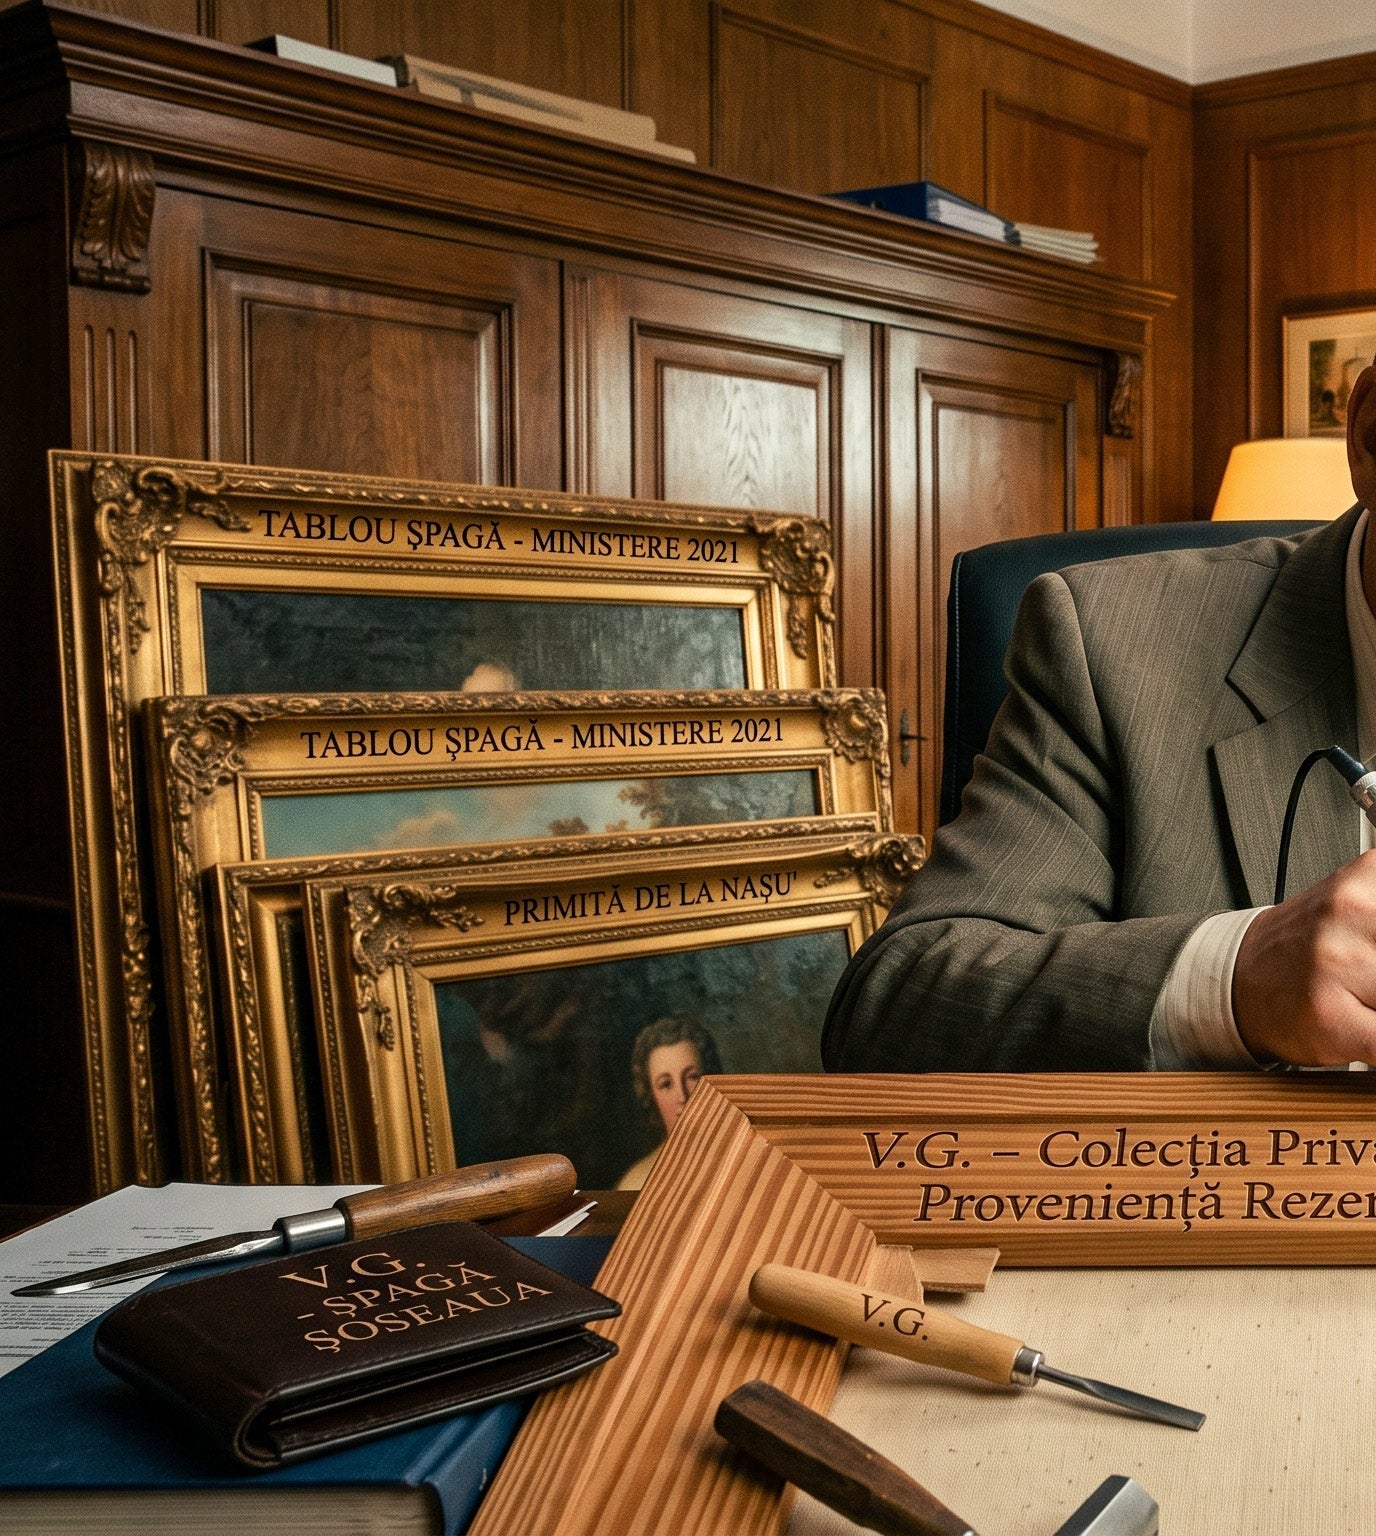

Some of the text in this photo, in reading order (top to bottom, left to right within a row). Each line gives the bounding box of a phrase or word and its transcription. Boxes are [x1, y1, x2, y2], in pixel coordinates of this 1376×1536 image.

[258, 509, 398, 545] TABLOU
[530, 527, 681, 560] MINISTERE
[687, 537, 739, 564] 2021
[300, 728, 437, 759] TABLOU
[571, 719, 724, 749] MINISTERE
[731, 717, 784, 744] 2021
[504, 884, 627, 926] PRIMITĂ
[634, 884, 671, 912] DE
[679, 880, 714, 906] LA
[862, 1131, 971, 1169] V.G.
[1038, 1128, 1250, 1179] Colecția
[913, 1181, 1225, 1233] Proveniență
[278, 1252, 427, 1289] V.G.
[860, 1292, 929, 1342] V.G.
